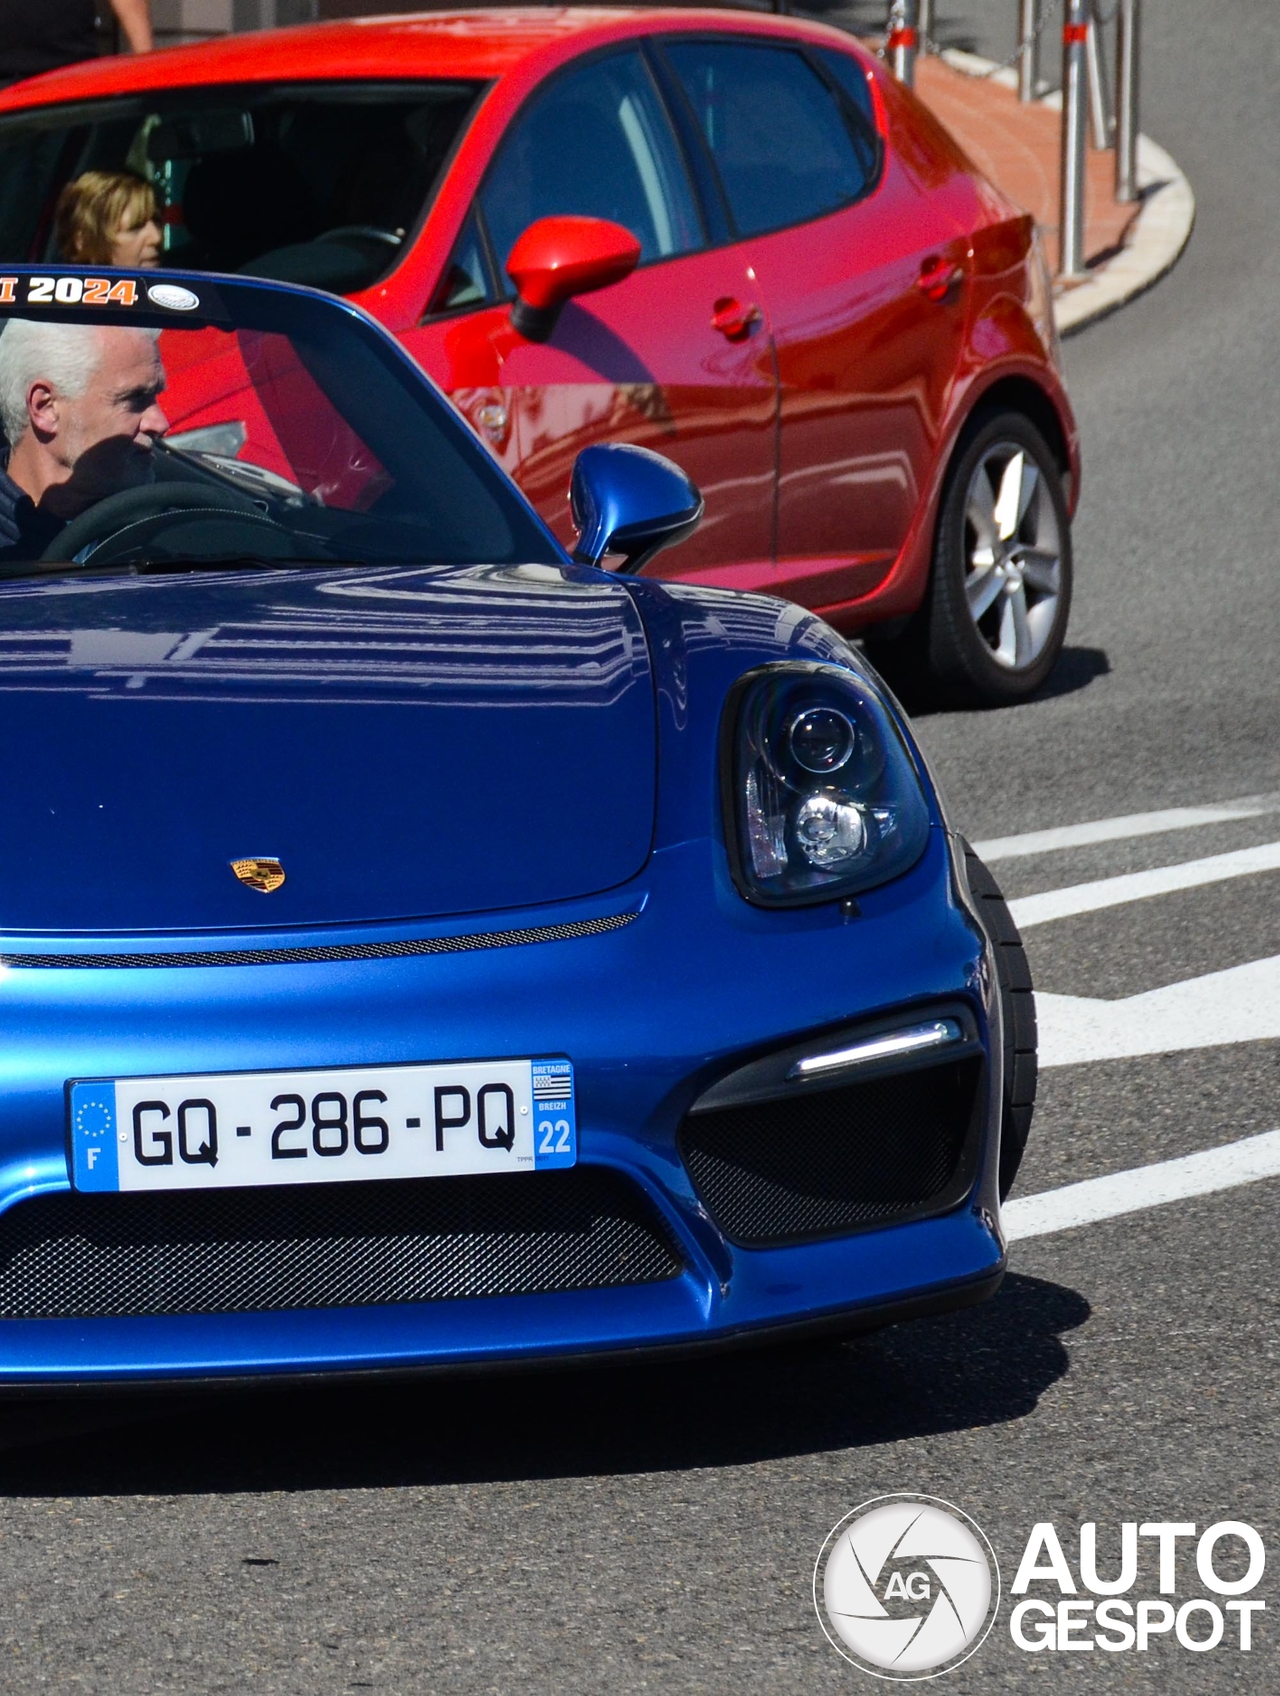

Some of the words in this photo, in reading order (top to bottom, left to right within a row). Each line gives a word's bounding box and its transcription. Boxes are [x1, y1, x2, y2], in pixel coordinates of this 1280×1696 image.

[27, 277, 138, 306] 2024
[533, 1065, 570, 1074] BRETAGNE
[538, 1101, 567, 1111] BREIZH
[538, 1119, 571, 1154] 22
[87, 1147, 101, 1170] F
